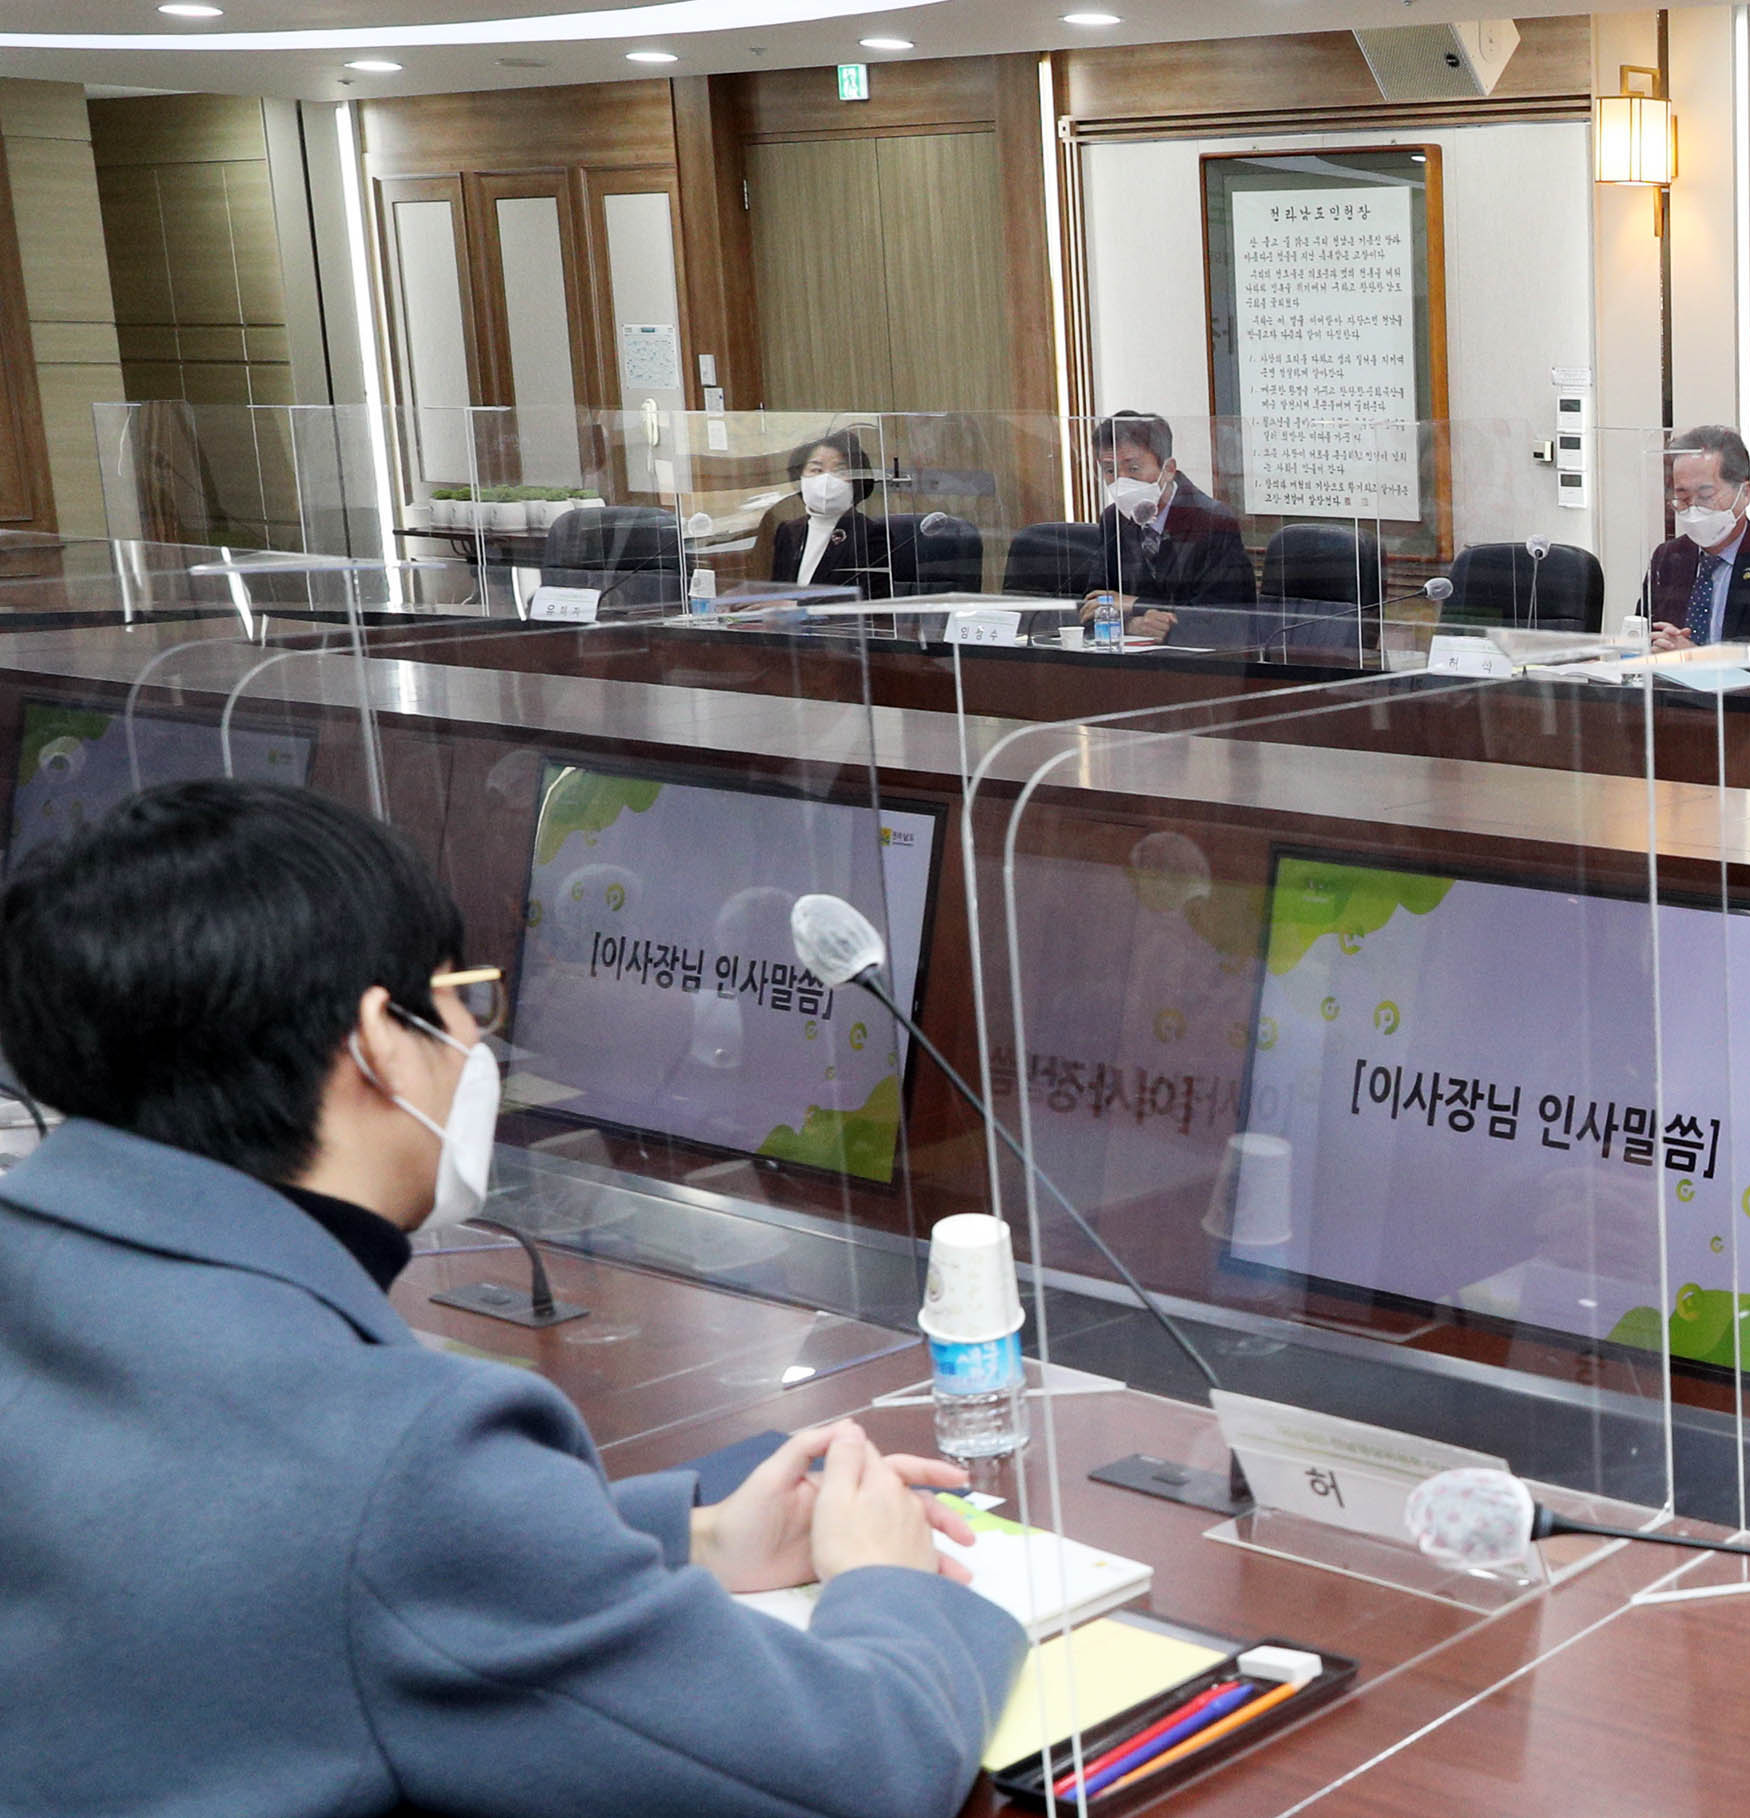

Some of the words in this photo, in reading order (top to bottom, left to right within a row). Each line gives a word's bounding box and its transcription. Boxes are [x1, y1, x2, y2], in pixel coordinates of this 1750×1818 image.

[591, 932, 704, 993] [이사장님
[715, 955, 834, 1021] 인사말씀]
[1351, 1058, 1521, 1141] [이사장님
[1538, 1094, 1721, 1180] 인사말씀]
[1304, 1466, 1346, 1509] 허
